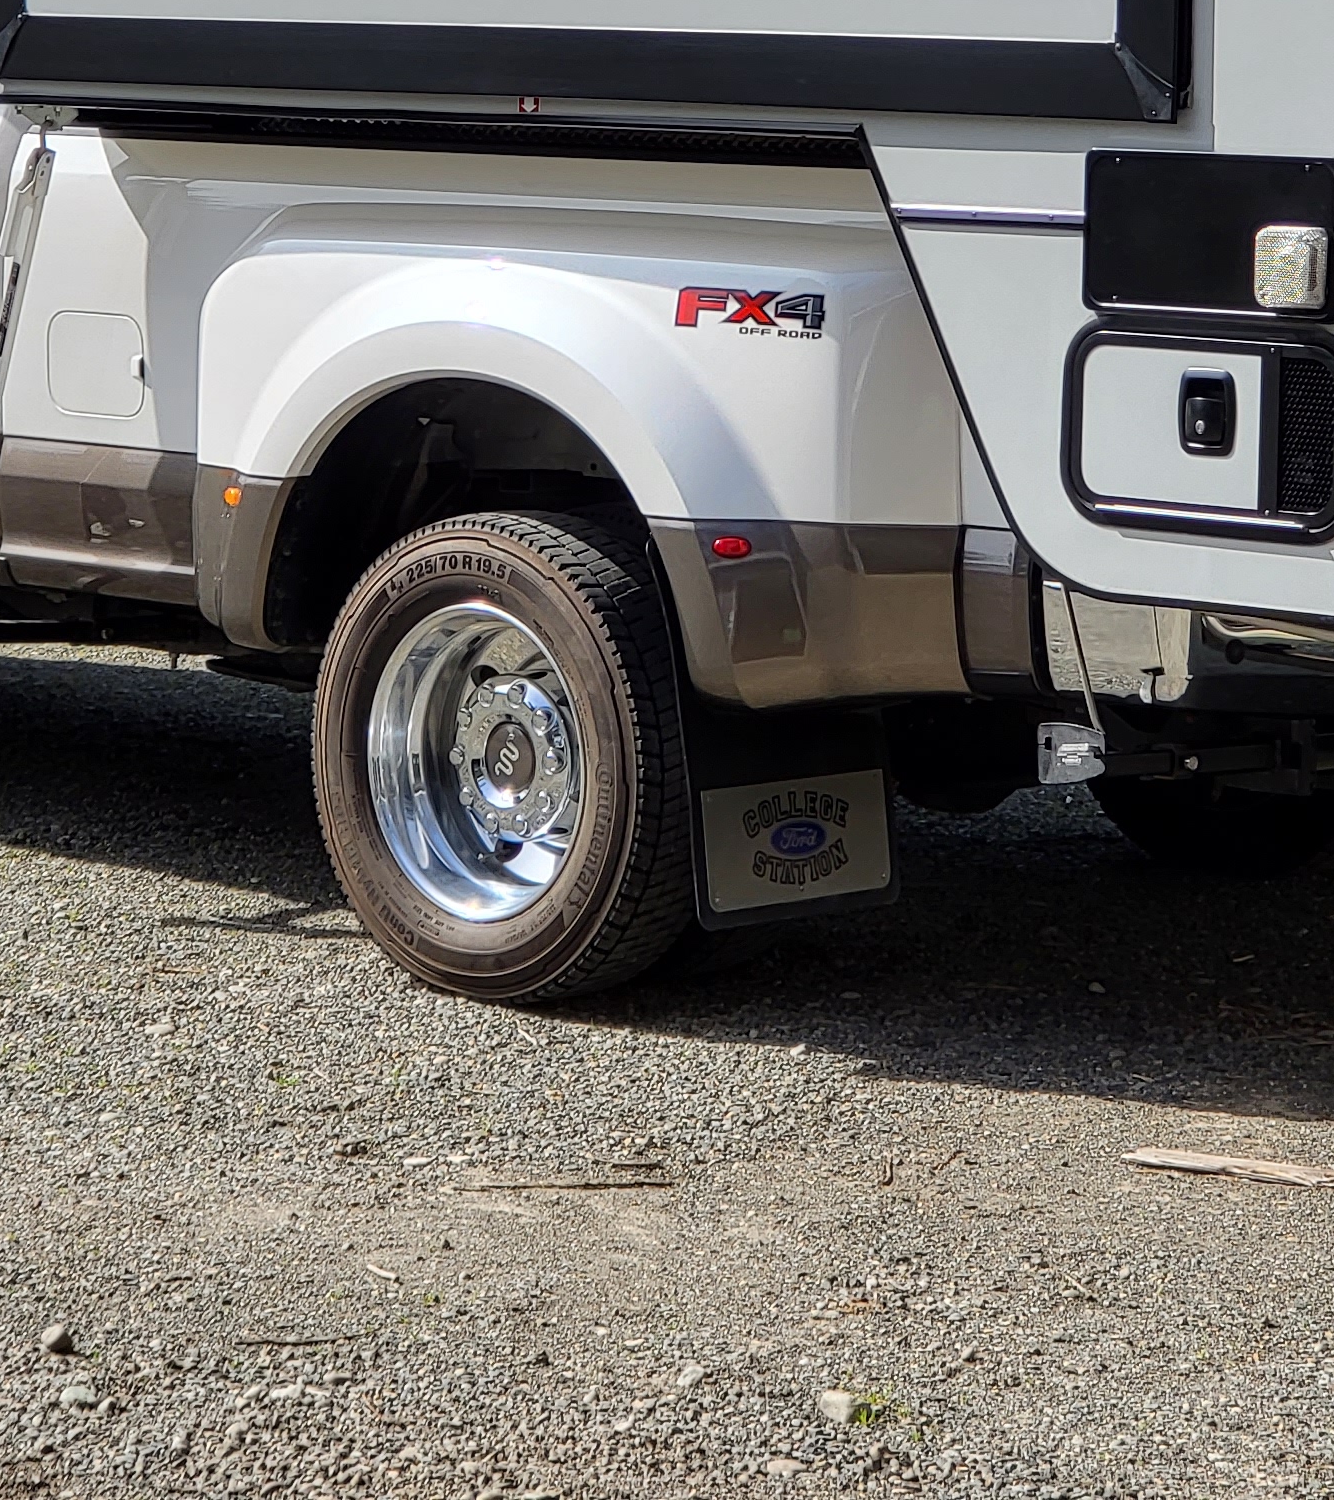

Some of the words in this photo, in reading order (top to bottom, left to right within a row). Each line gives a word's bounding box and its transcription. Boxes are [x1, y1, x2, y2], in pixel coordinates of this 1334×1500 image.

[674, 285, 826, 330] FX4
[738, 326, 771, 336] OFF
[776, 329, 822, 340] ROAD
[406, 555, 458, 583] 225/70
[742, 790, 849, 839] COLLEGE
[779, 827, 818, 850] Ford
[752, 838, 849, 885] STATION
